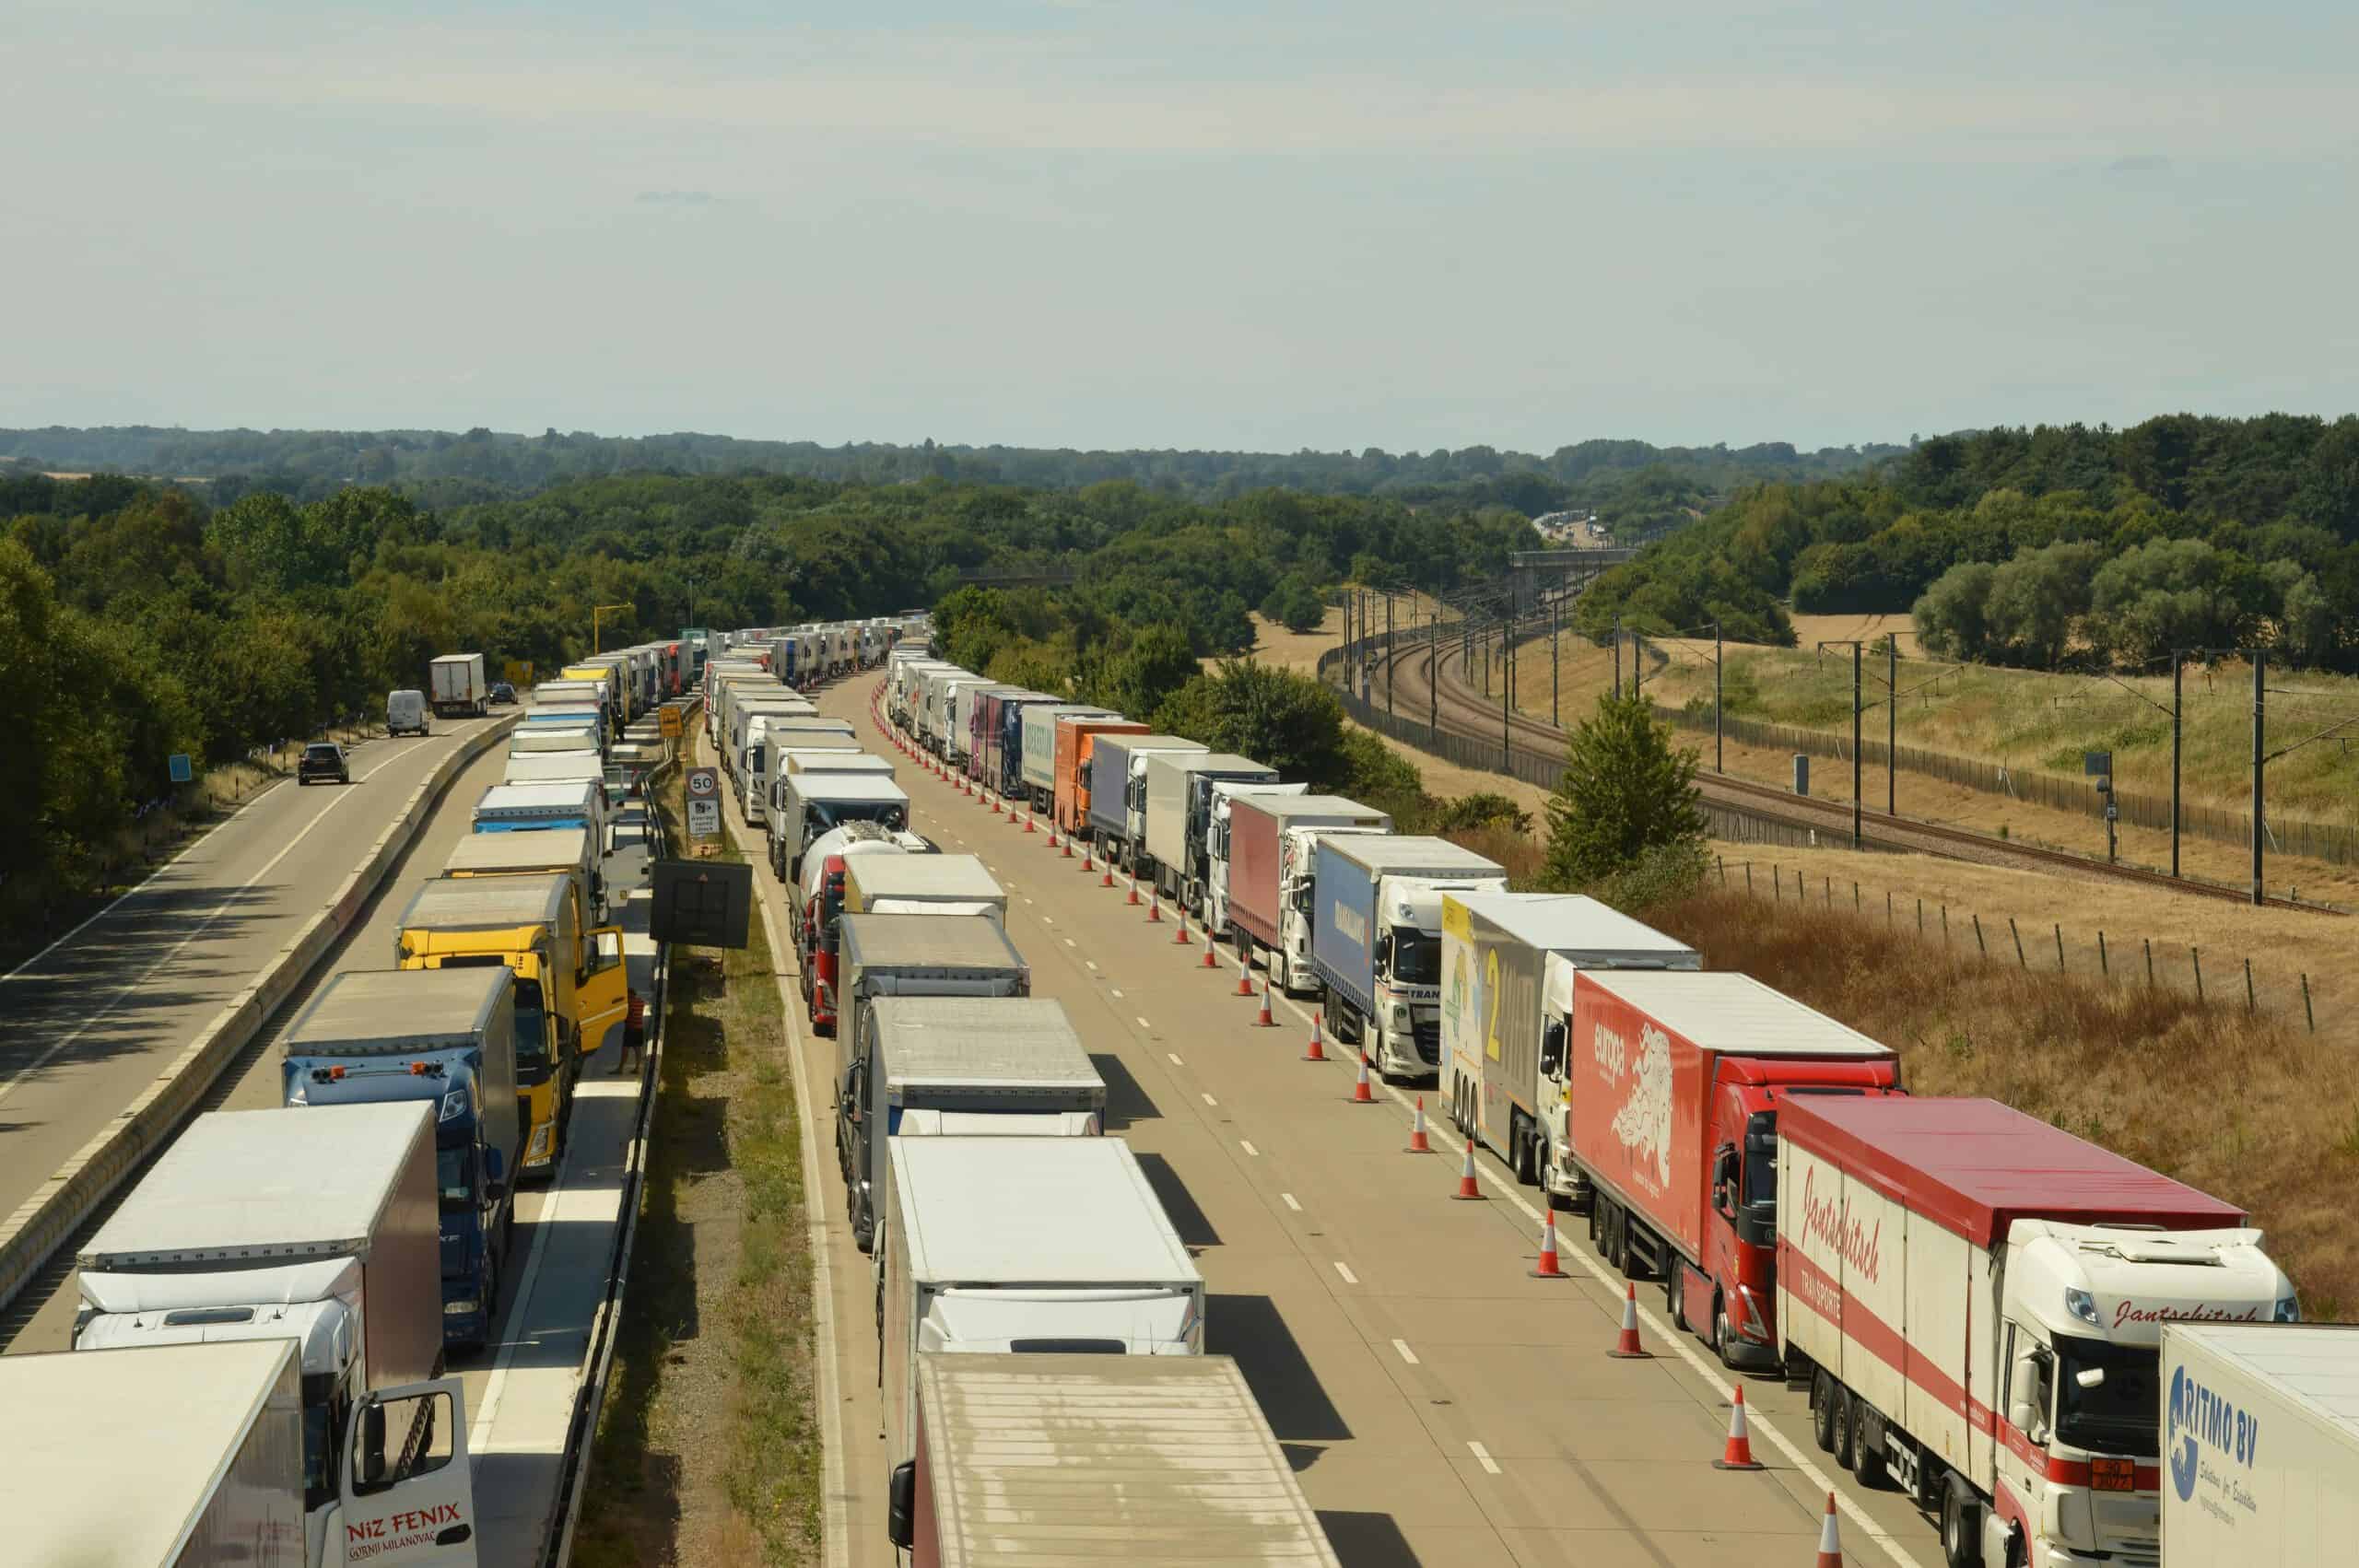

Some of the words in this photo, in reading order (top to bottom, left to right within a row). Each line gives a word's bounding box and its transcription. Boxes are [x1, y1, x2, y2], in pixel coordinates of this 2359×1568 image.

[692, 777, 712, 790] 50
[1594, 1021, 1625, 1091] europa
[1802, 1164, 1880, 1284] Jantschitsch
[1802, 1269, 1842, 1320] TRANSPORTE
[2186, 1377, 2232, 1455] RITMO
[2236, 1409, 2258, 1469] BV
[382, 1531, 436, 1552] MILANOVAC
[392, 1502, 462, 1533] FENIX
